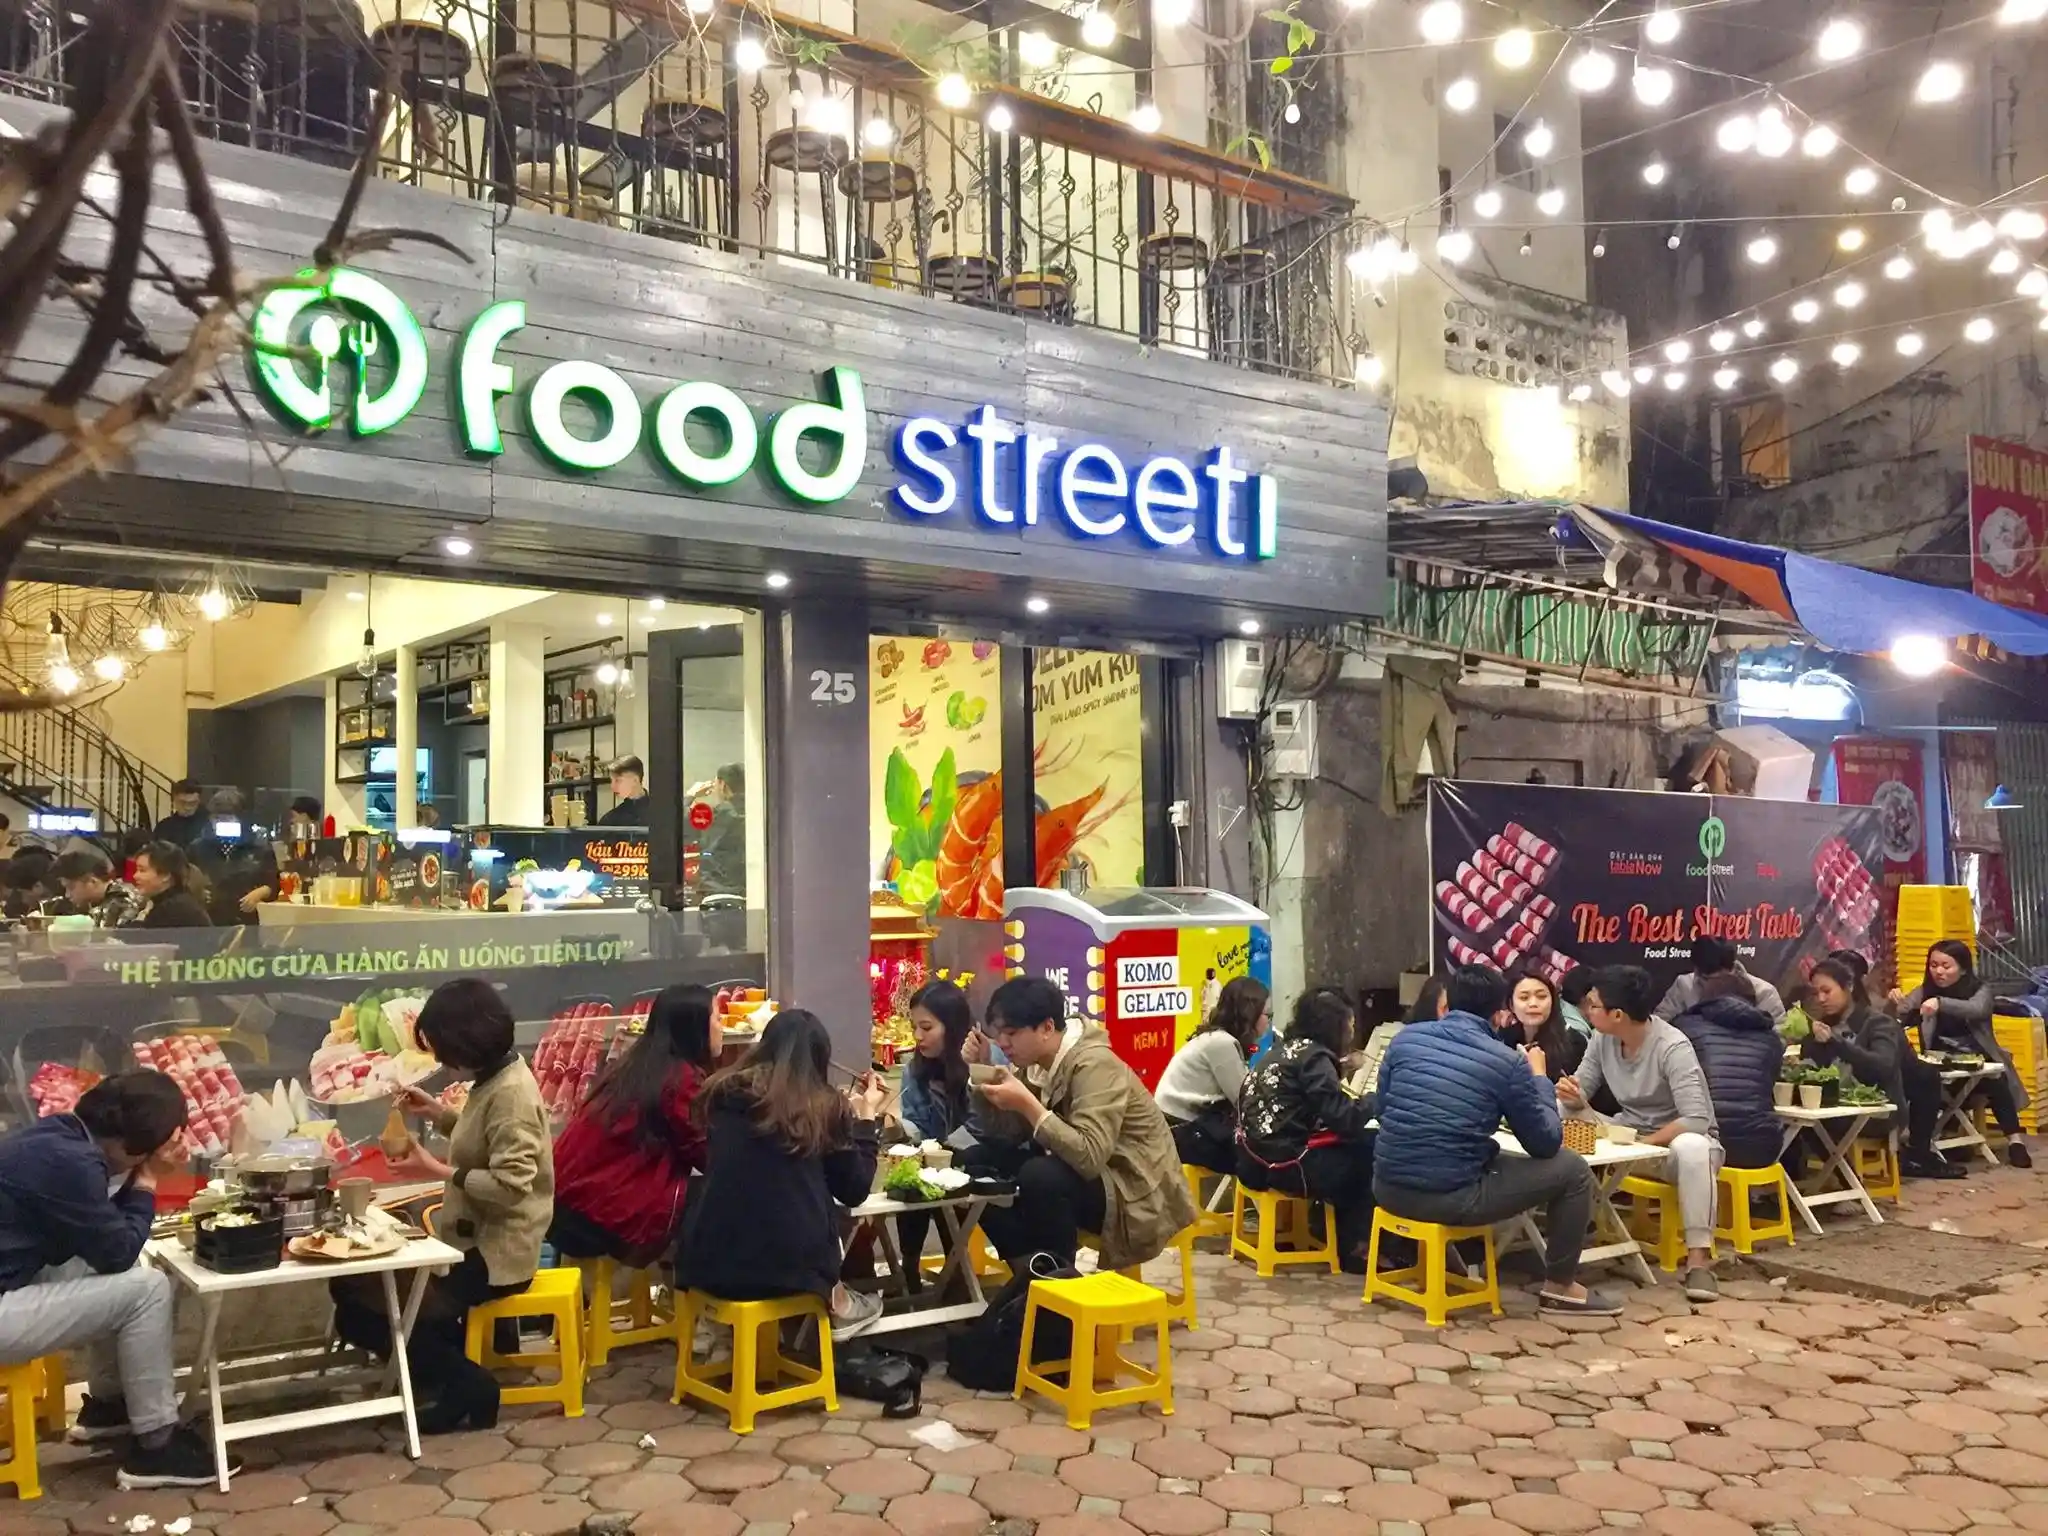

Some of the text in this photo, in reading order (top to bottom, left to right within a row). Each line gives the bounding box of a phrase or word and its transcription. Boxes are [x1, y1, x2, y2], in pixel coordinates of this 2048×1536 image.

[458, 300, 1248, 557] food street
[811, 670, 856, 703] 25
[1061, 660, 1103, 700] YUM
[613, 864, 649, 877] 299K
[1572, 902, 1804, 944] The Best Street Taste
[167, 949, 265, 983] THỐNG
[271, 948, 329, 977] CỬA
[336, 947, 409, 973] HÀNG
[414, 943, 449, 970] ĂN
[459, 938, 526, 968] UỐNG
[1644, 946, 1667, 959] Food
[1669, 946, 1692, 959] Stree
[1044, 967, 1069, 990] WE
[1124, 962, 1173, 983] KOMO
[1124, 991, 1187, 1013] GELATO
[1133, 1031, 1158, 1051] KEM
